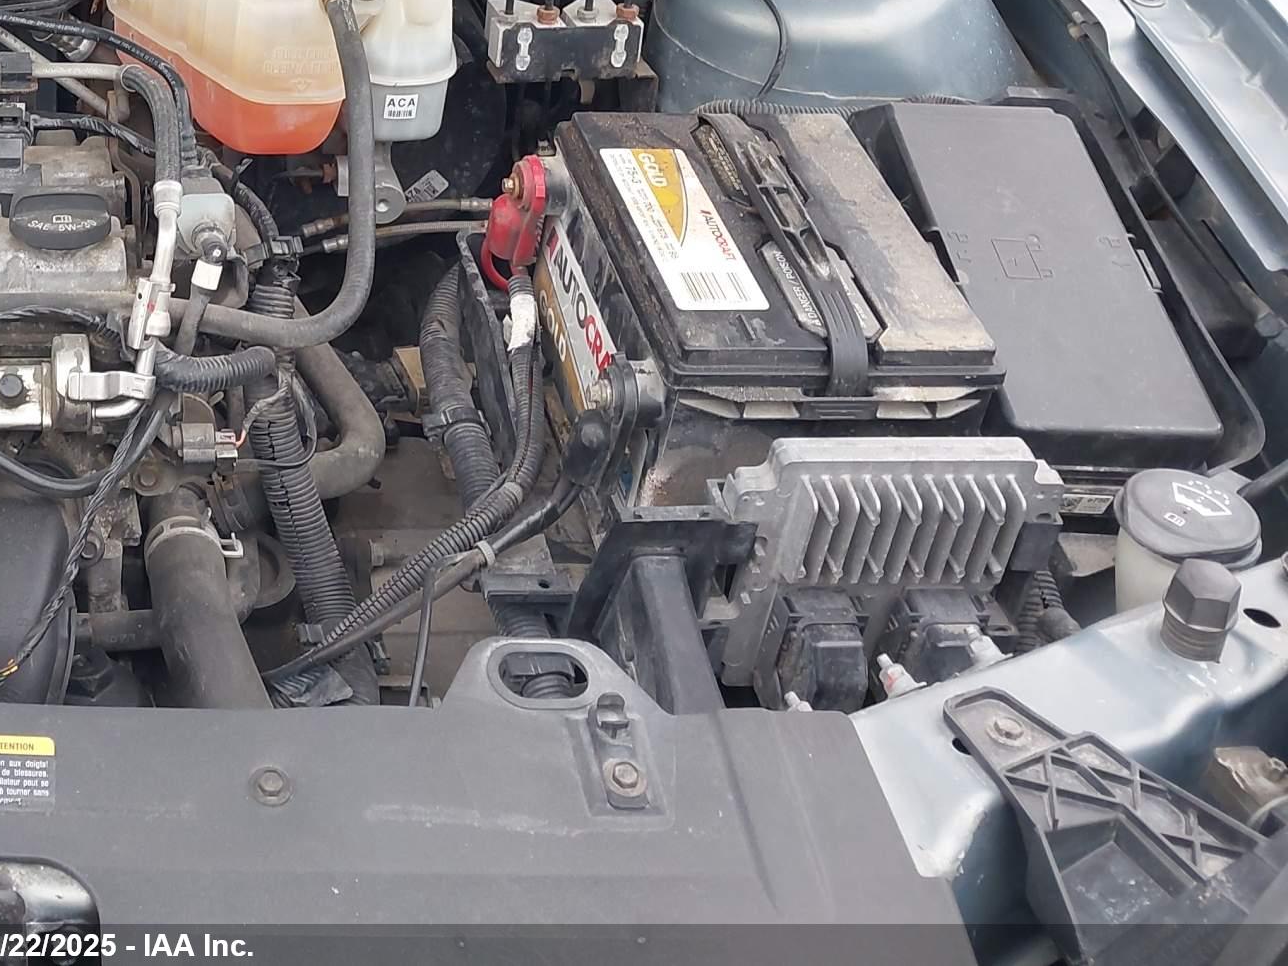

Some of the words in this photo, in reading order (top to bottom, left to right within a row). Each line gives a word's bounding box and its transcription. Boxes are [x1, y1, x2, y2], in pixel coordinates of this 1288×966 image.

[387, 97, 415, 107] ACA
[27, 220, 50, 231] SAE
[703, 215, 737, 261] AUTOCRAFT
[792, 284, 818, 321] DANGER
[1, 768, 10, 776] de
